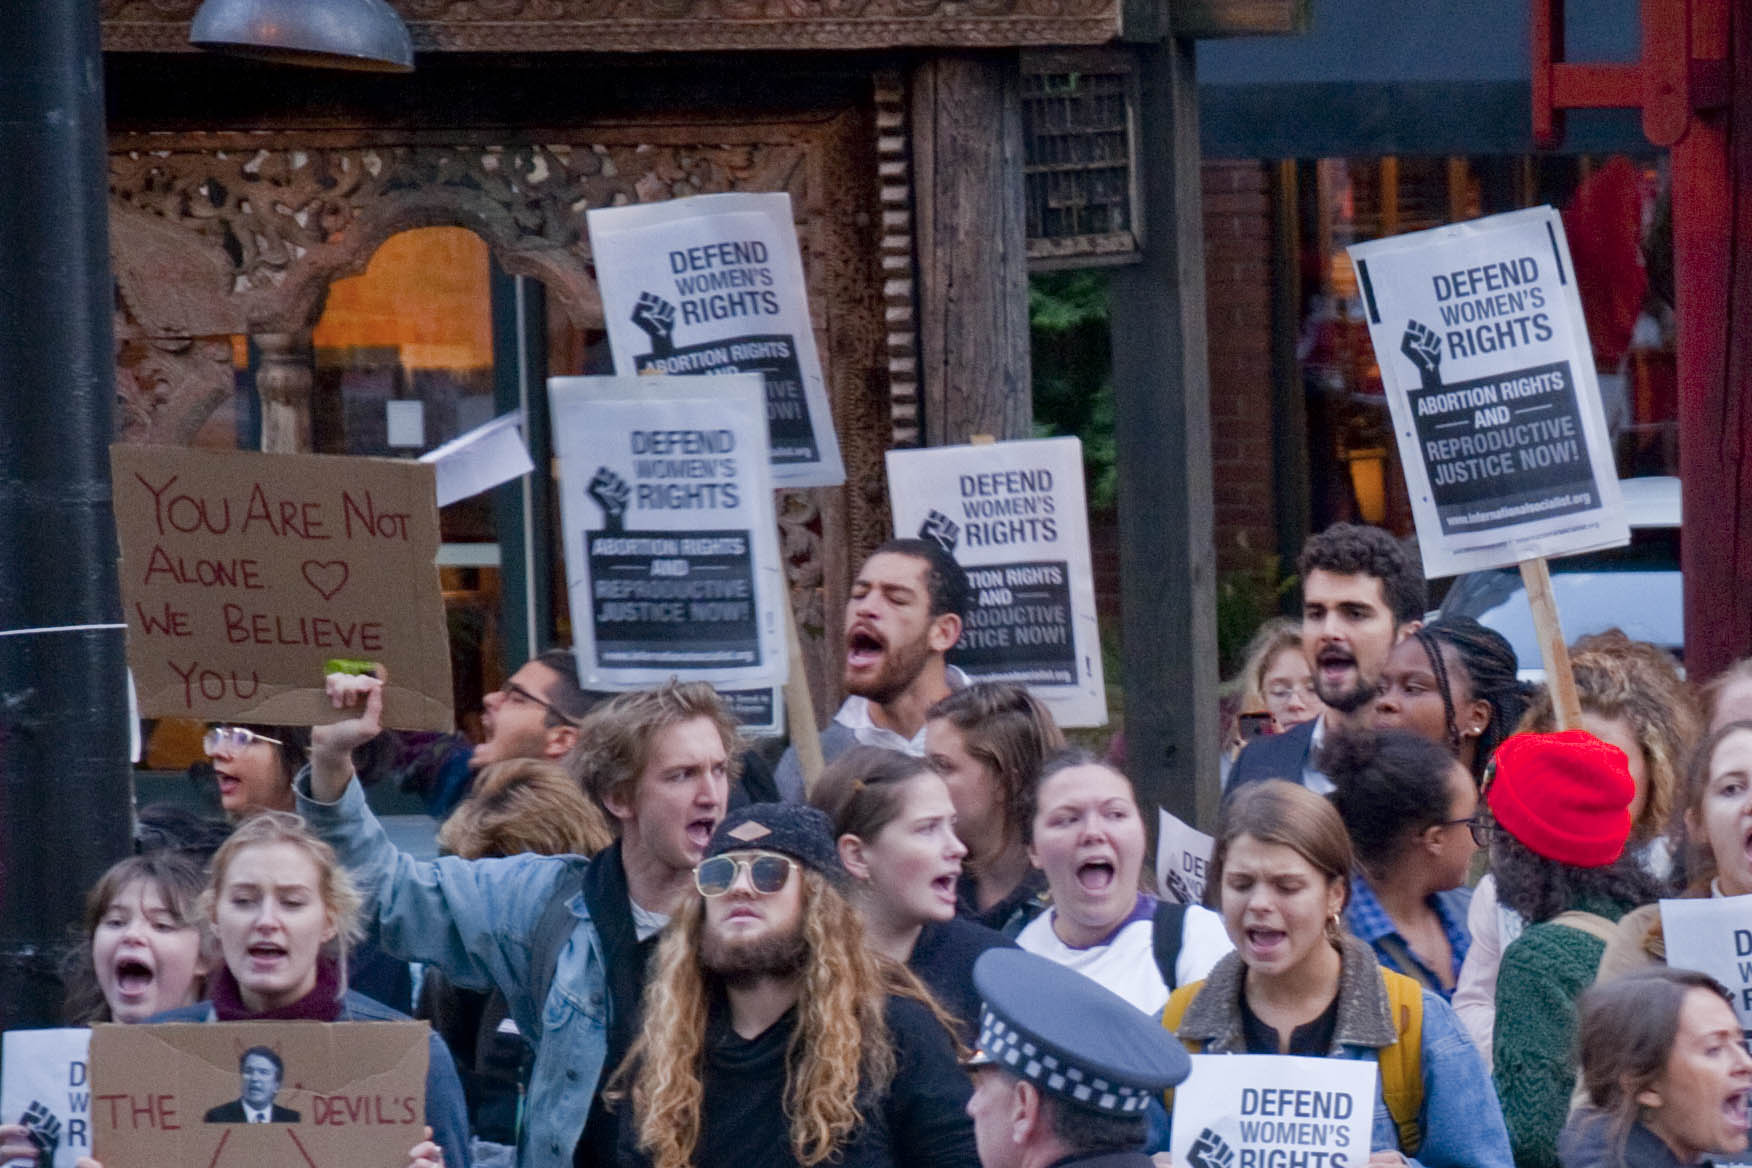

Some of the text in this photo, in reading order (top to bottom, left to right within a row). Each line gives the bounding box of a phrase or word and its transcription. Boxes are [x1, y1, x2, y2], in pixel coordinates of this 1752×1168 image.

[669, 240, 769, 274] DEFEND
[675, 267, 774, 296] WOMEN'S
[1432, 257, 1539, 301] DEFEND
[681, 291, 780, 326] RIGHTS
[1440, 286, 1546, 327] WOMEN'S
[1446, 313, 1553, 360] RIGHTS
[733, 342, 790, 362] RIGHTS
[1417, 371, 1565, 417] ABORTION RIGHTS
[1474, 406, 1511, 429] AND
[630, 429, 736, 454] DEFEND
[1426, 416, 1576, 462] REPRODUCTIVE
[633, 459, 738, 479] WOMEN'S
[1434, 440, 1580, 486] JUSTICE NOW!
[637, 483, 741, 509] RIGHTS
[960, 469, 1053, 498] DEFEND
[962, 495, 1055, 519] WOMEN'S
[965, 519, 1058, 548] RIGHTS
[145, 544, 264, 589] ALONE
[966, 567, 1062, 589] TION RIGHTS
[978, 588, 1012, 606] AND
[136, 602, 383, 651] WE BELIEVE
[598, 602, 685, 622] JUSTICE
[965, 605, 1066, 627] RODUCTIVE
[956, 625, 1067, 650] STICE NOW!
[168, 660, 259, 709] YOU
[100, 1094, 181, 1131] THE
[313, 1095, 417, 1126] DEVIL'S
[1240, 1088, 1354, 1120] DEFEND
[1240, 1121, 1351, 1148] WOMEN'S
